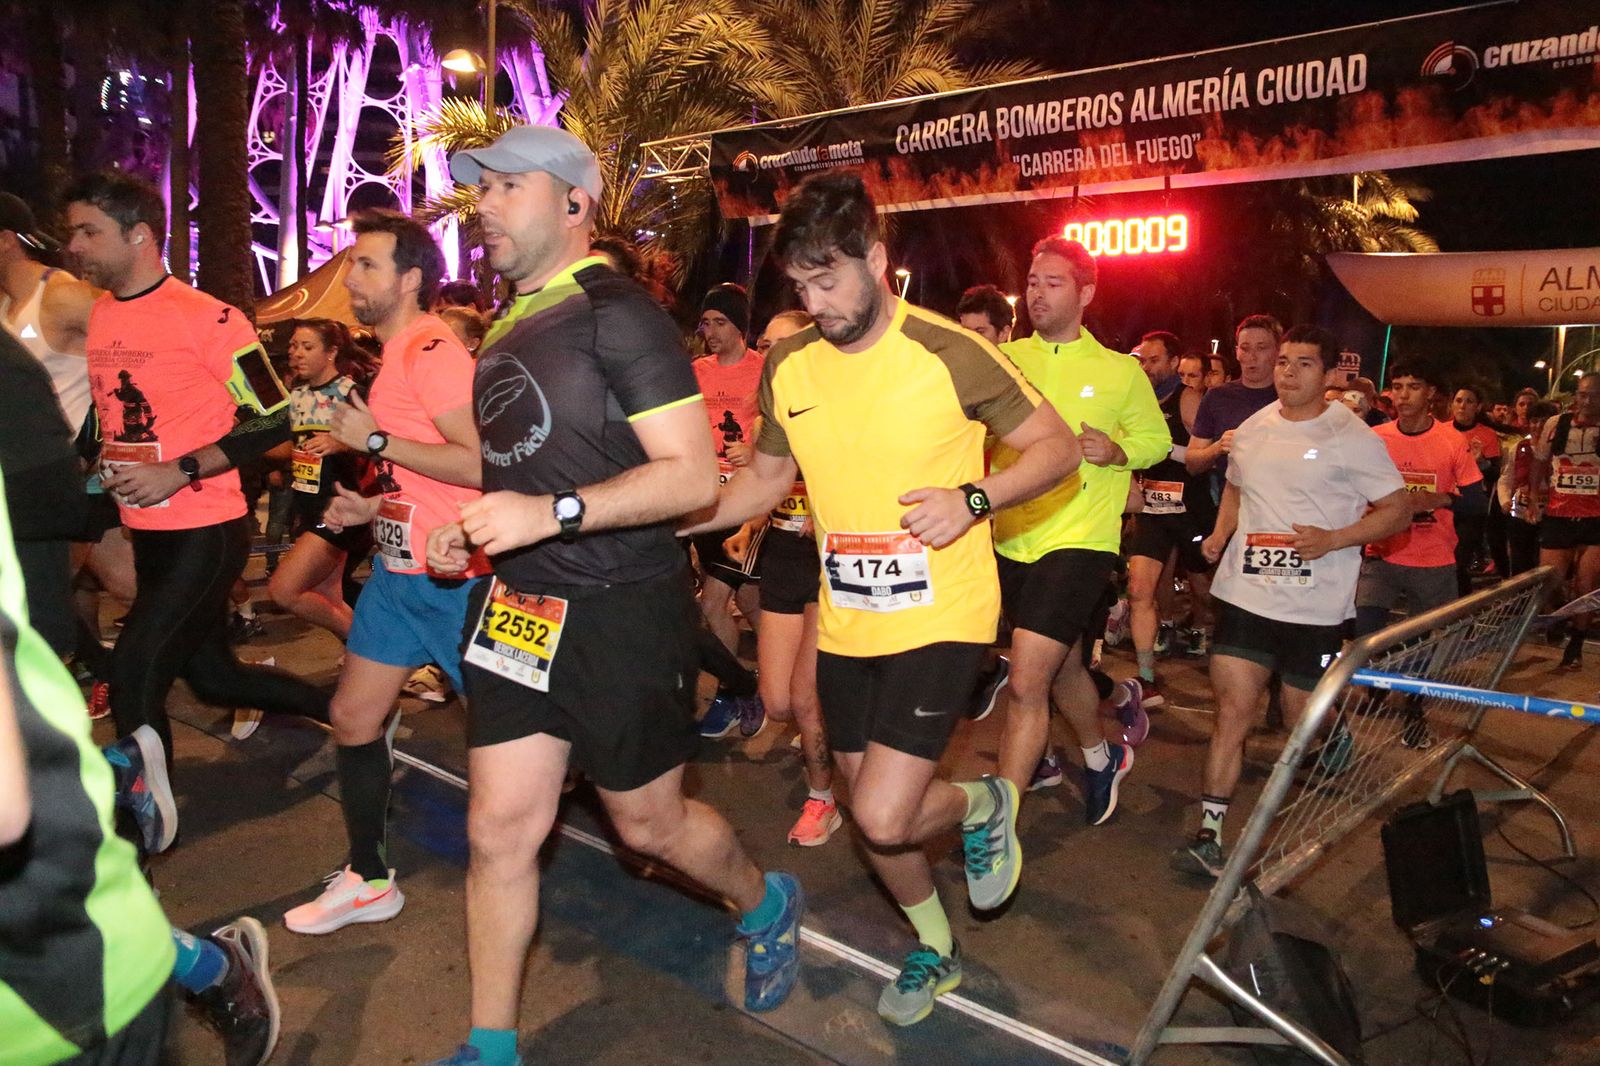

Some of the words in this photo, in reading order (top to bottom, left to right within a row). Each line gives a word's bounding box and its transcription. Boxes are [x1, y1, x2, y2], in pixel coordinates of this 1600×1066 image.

[1483, 25, 1600, 69] cruzand
[895, 107, 991, 155] CARRERA
[996, 91, 1124, 140] BOMBEROS
[1130, 66, 1250, 124] ALMERÍA
[1256, 53, 1368, 107] CIUDAD
[1101, 141, 1133, 169] DEL
[513, 424, 549, 463] Fácil
[1567, 475, 1594, 485] 159
[1151, 491, 1172, 502] 483
[380, 519, 404, 548] 329
[853, 558, 902, 578] 174
[1258, 548, 1303, 568] 325
[495, 610, 550, 648] 2552
